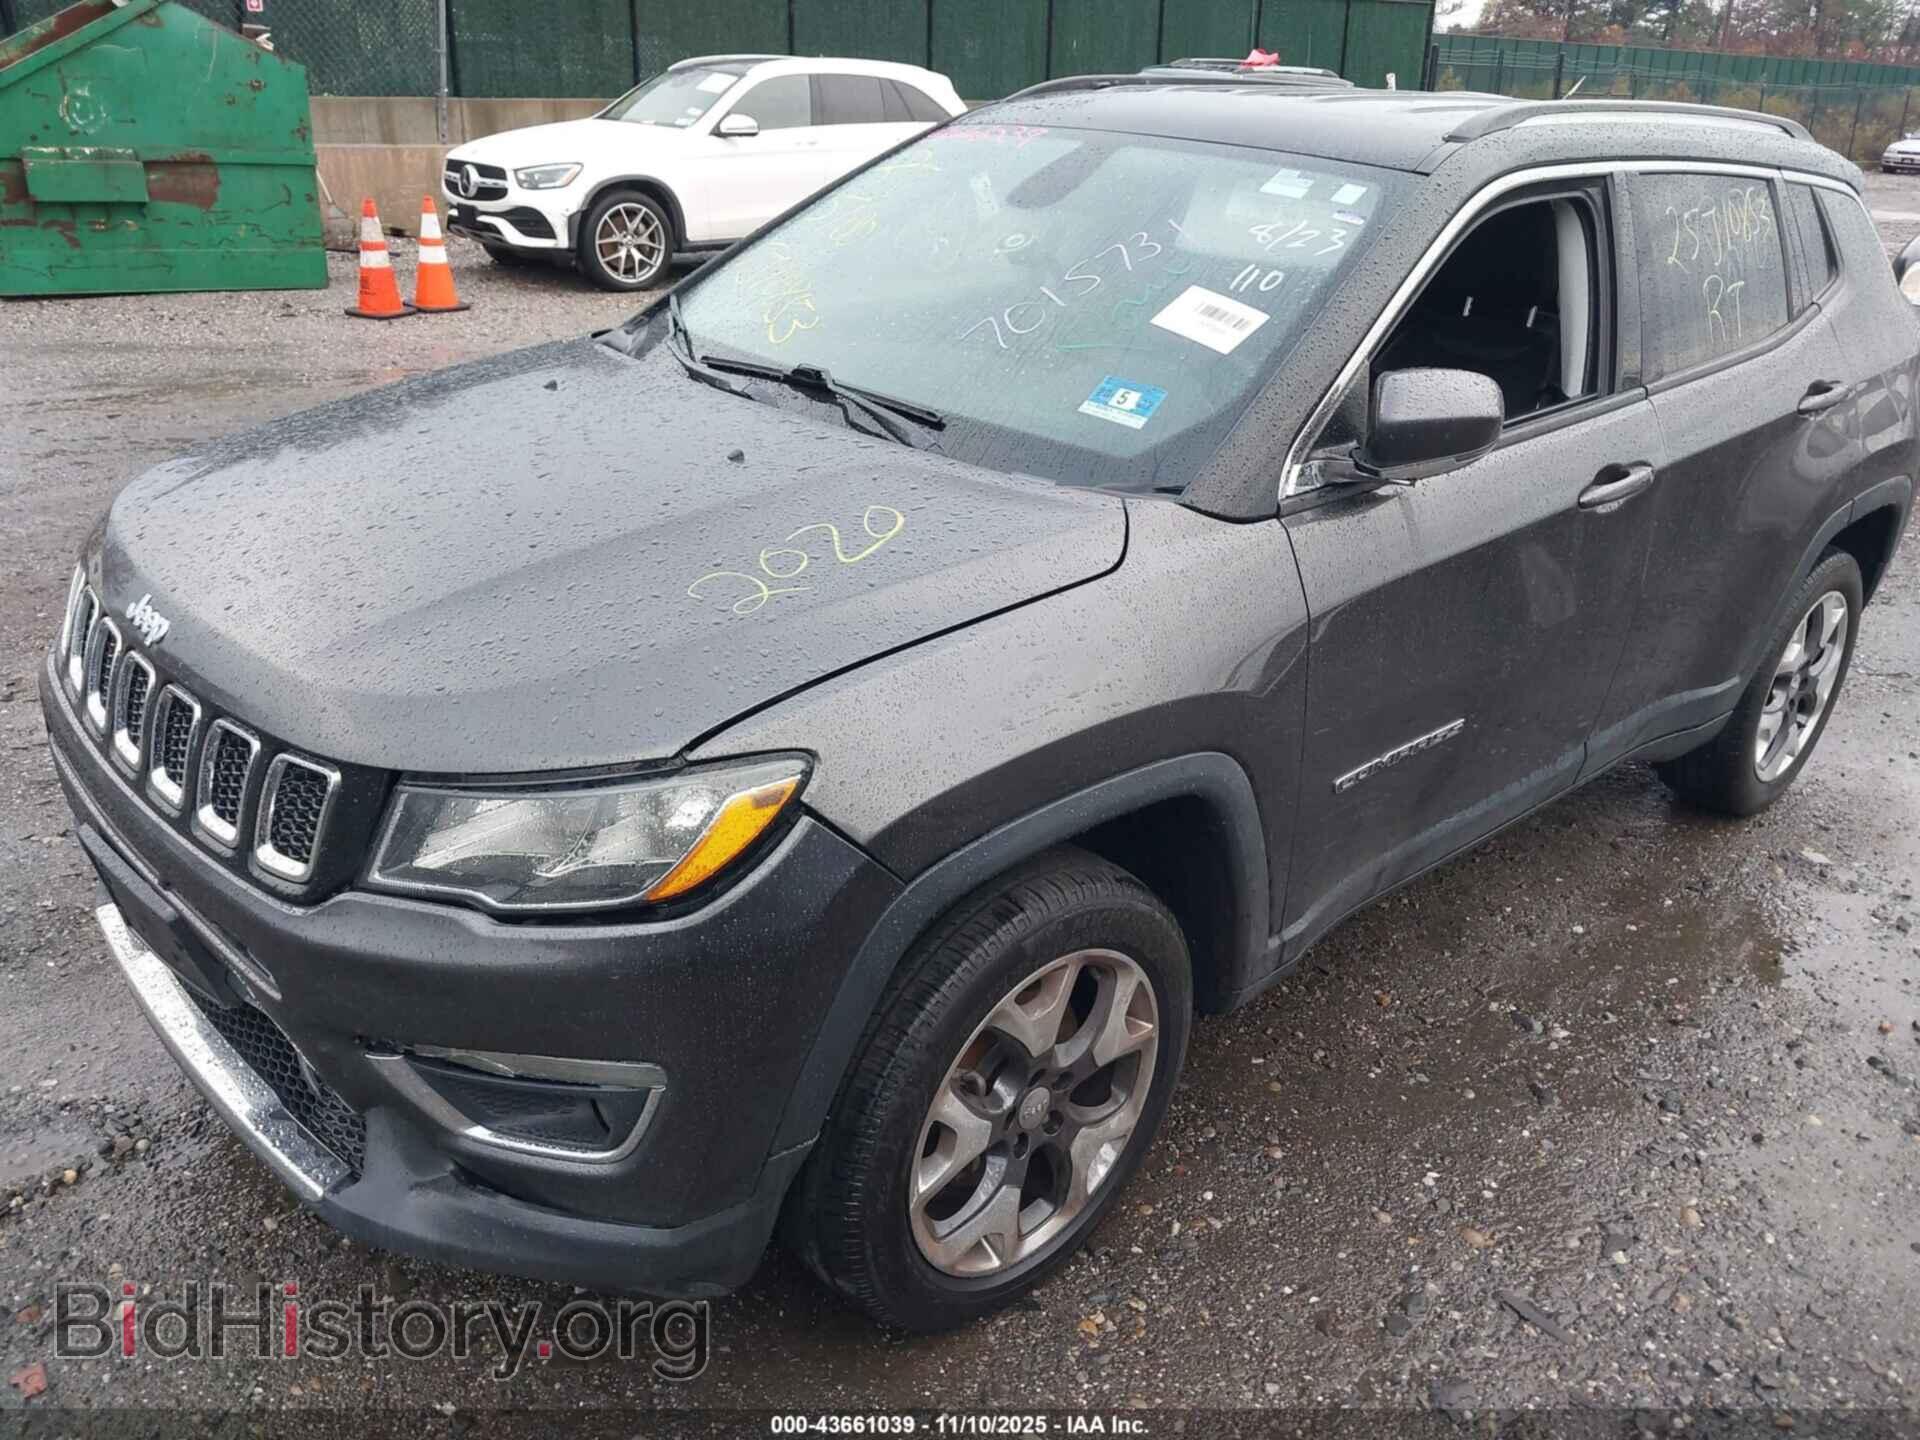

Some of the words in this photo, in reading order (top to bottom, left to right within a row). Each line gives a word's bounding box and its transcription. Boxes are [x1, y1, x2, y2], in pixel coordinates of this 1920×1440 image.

[1229, 263, 1284, 292] 110
[1116, 391, 1131, 406] 5
[687, 504, 905, 615] 2020
[126, 592, 171, 647] Jeep
